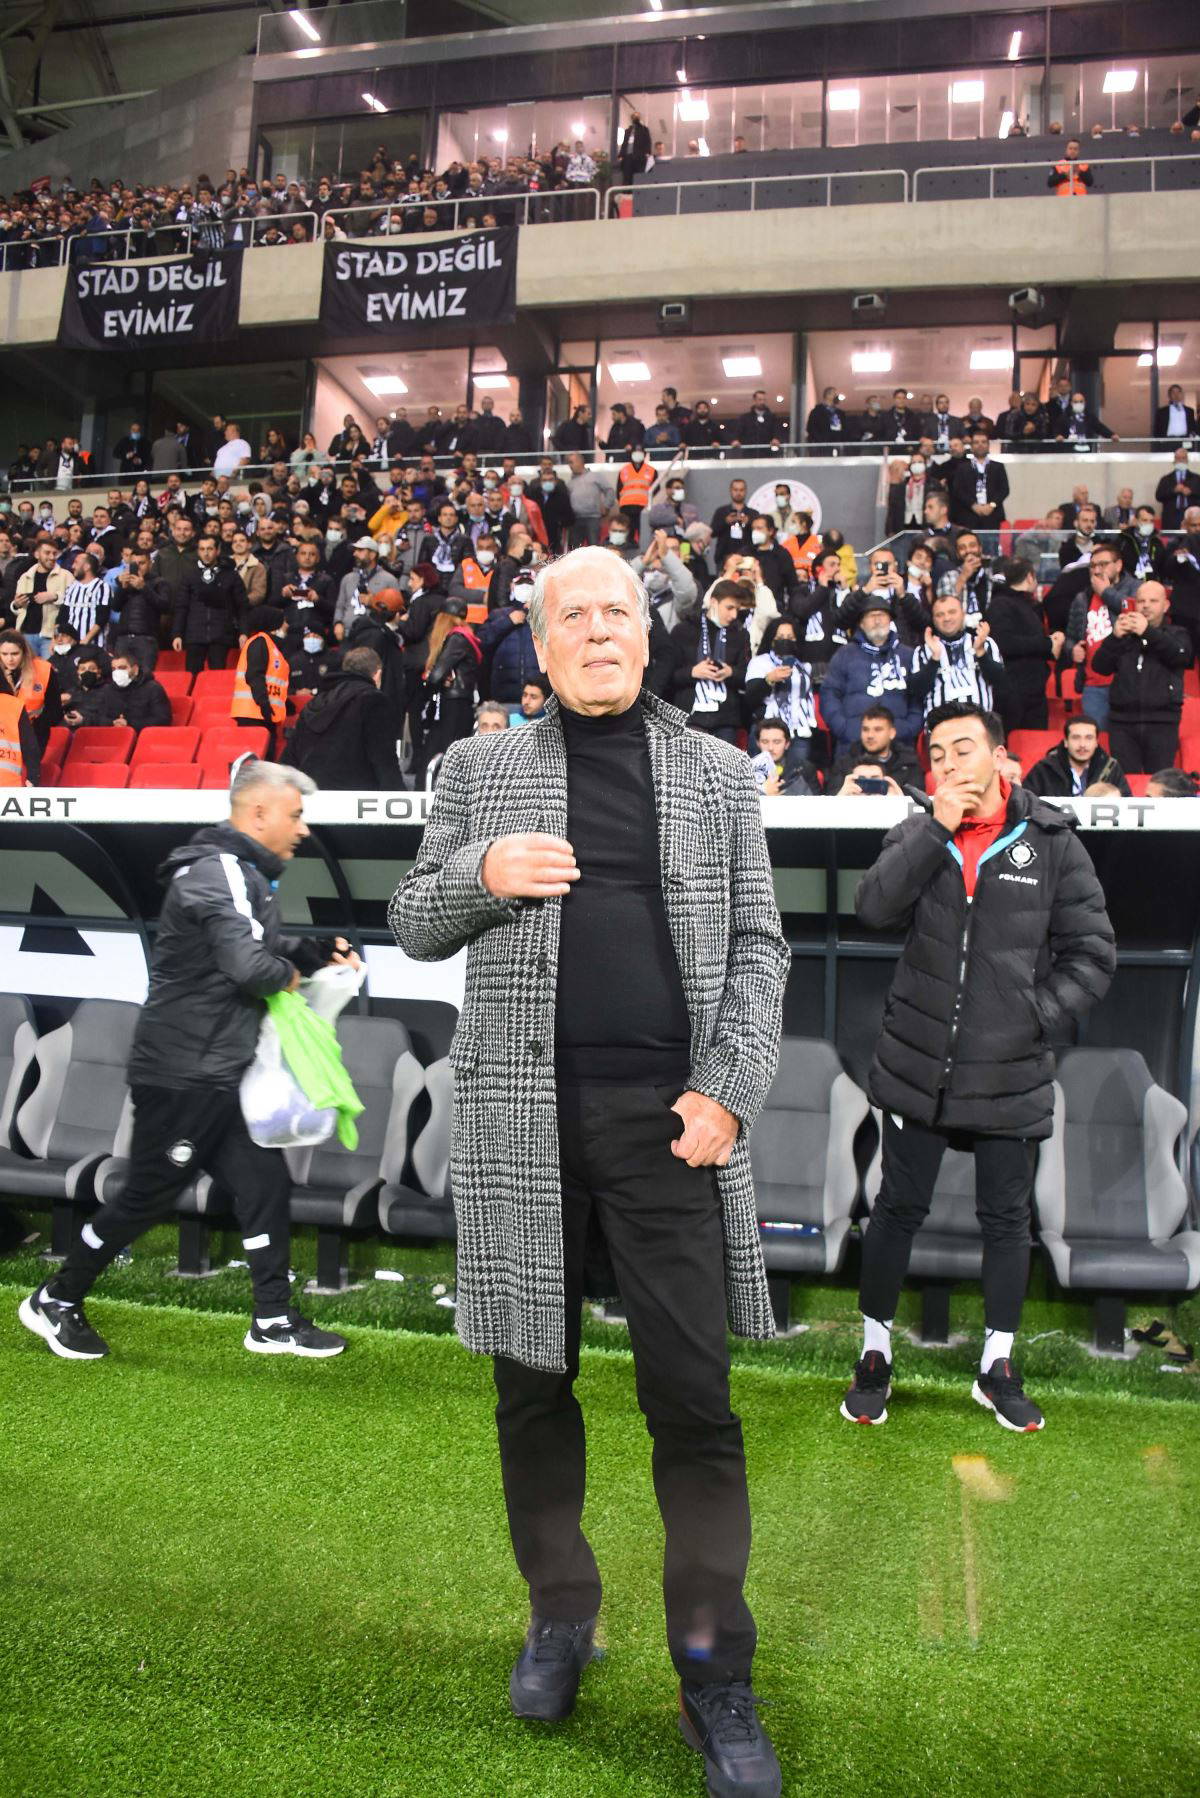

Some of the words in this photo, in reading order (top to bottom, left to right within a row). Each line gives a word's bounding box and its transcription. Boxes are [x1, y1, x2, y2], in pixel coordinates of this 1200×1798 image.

[336, 250, 408, 280] STAD
[416, 236, 502, 275] DEĞİL
[78, 267, 140, 298] STAD
[104, 299, 195, 337] EVİMİZ
[366, 281, 467, 322] EVİMİZ
[1, 797, 77, 817] ART
[998, 873, 1039, 886] FOLKART
